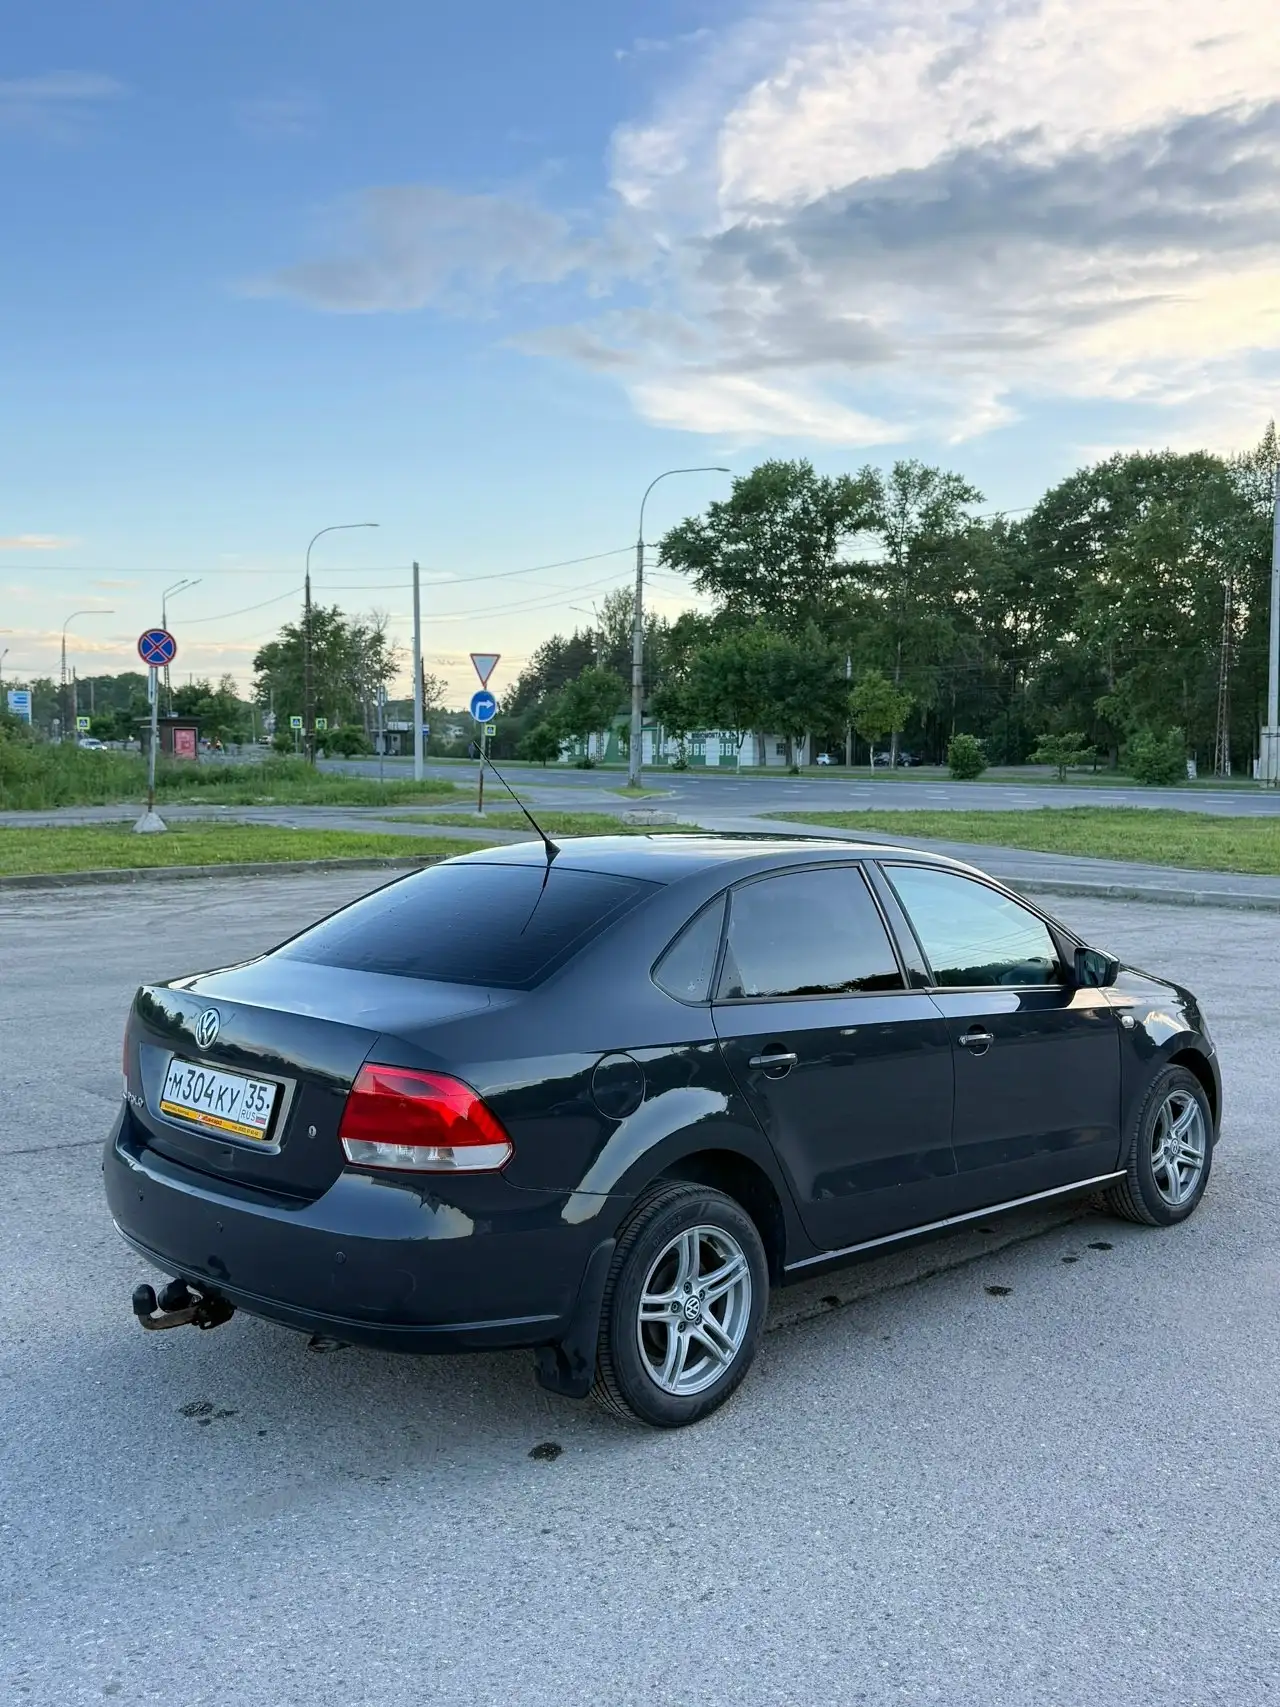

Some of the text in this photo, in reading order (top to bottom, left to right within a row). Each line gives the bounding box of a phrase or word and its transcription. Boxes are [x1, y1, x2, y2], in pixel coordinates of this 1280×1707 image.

[170, 1069, 268, 1114] М304КУ 35
[240, 1109, 256, 1121] RUS
